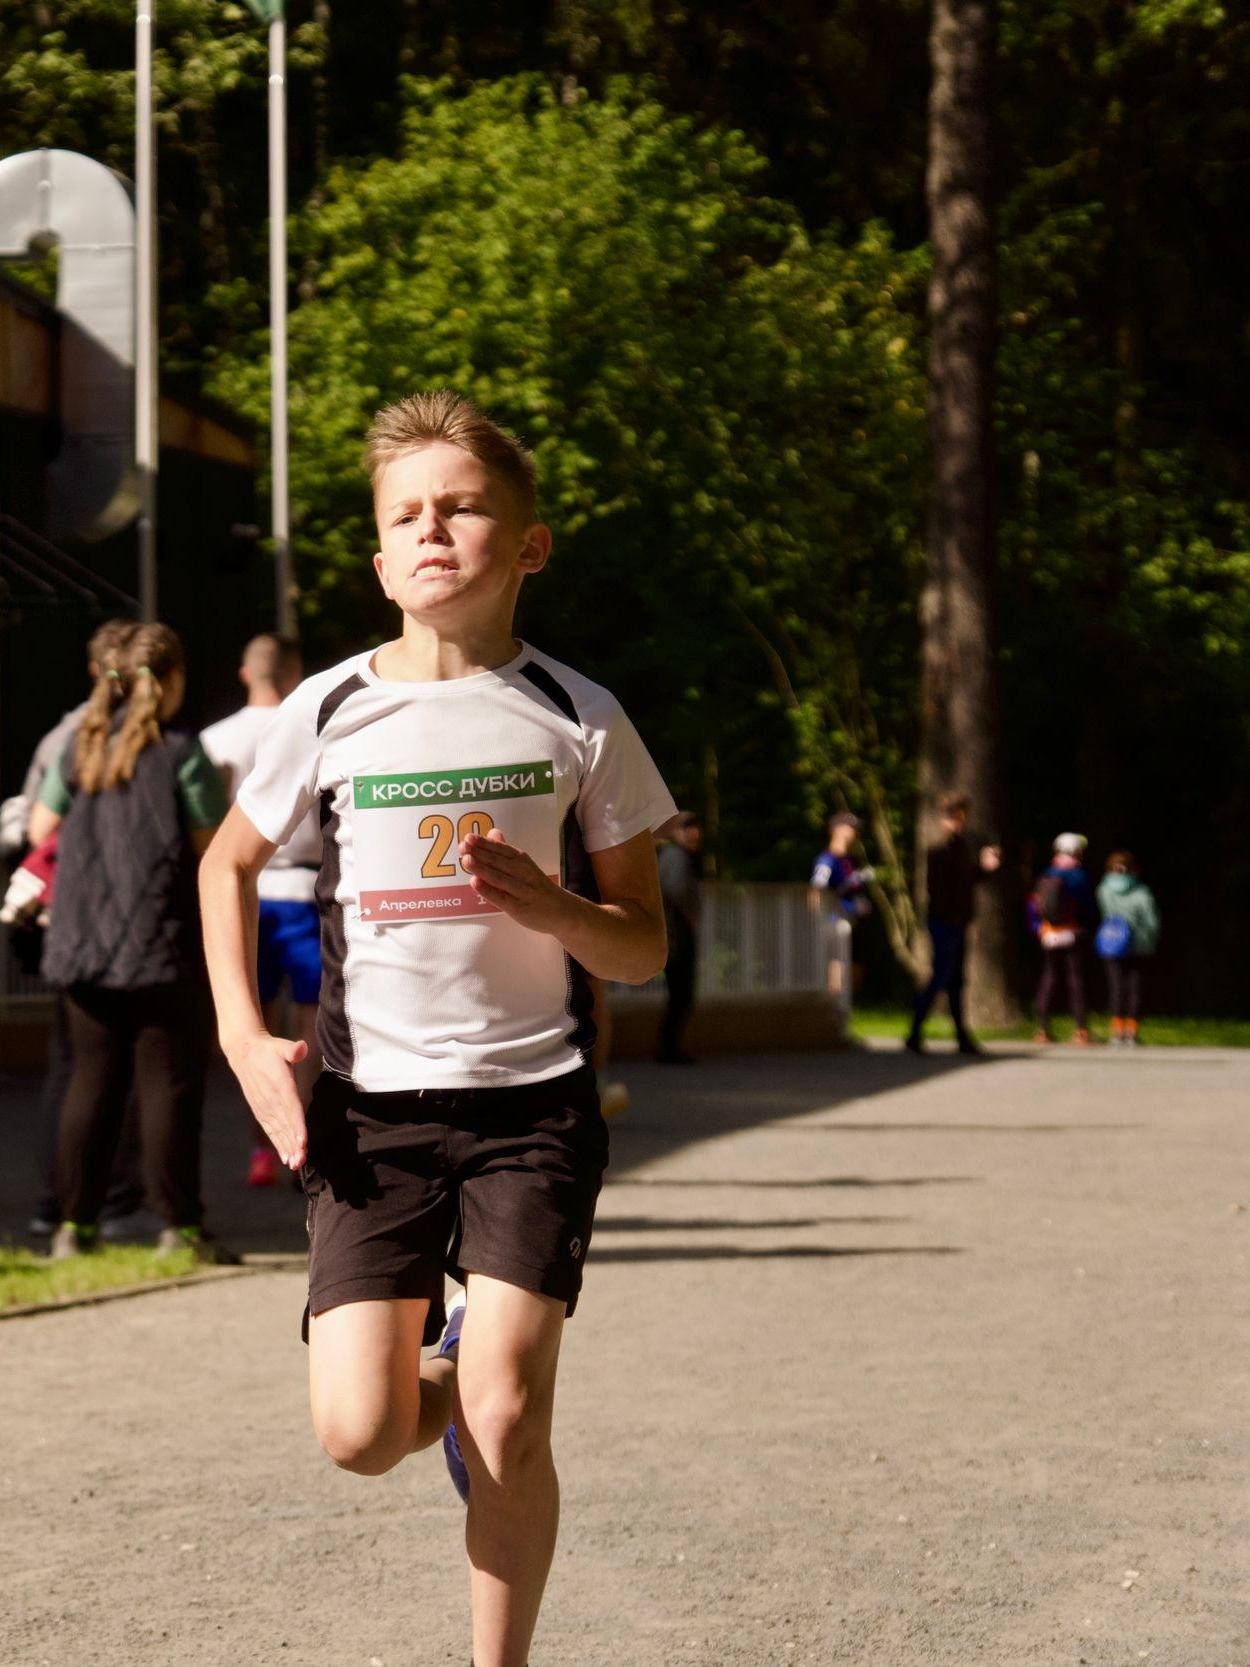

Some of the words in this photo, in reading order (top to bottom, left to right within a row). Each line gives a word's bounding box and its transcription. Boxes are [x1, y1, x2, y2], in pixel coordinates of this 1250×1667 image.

[372, 780, 454, 801] КРОСС
[459, 772, 536, 799] ДУБКИ
[379, 898, 462, 912] Апрелевка
